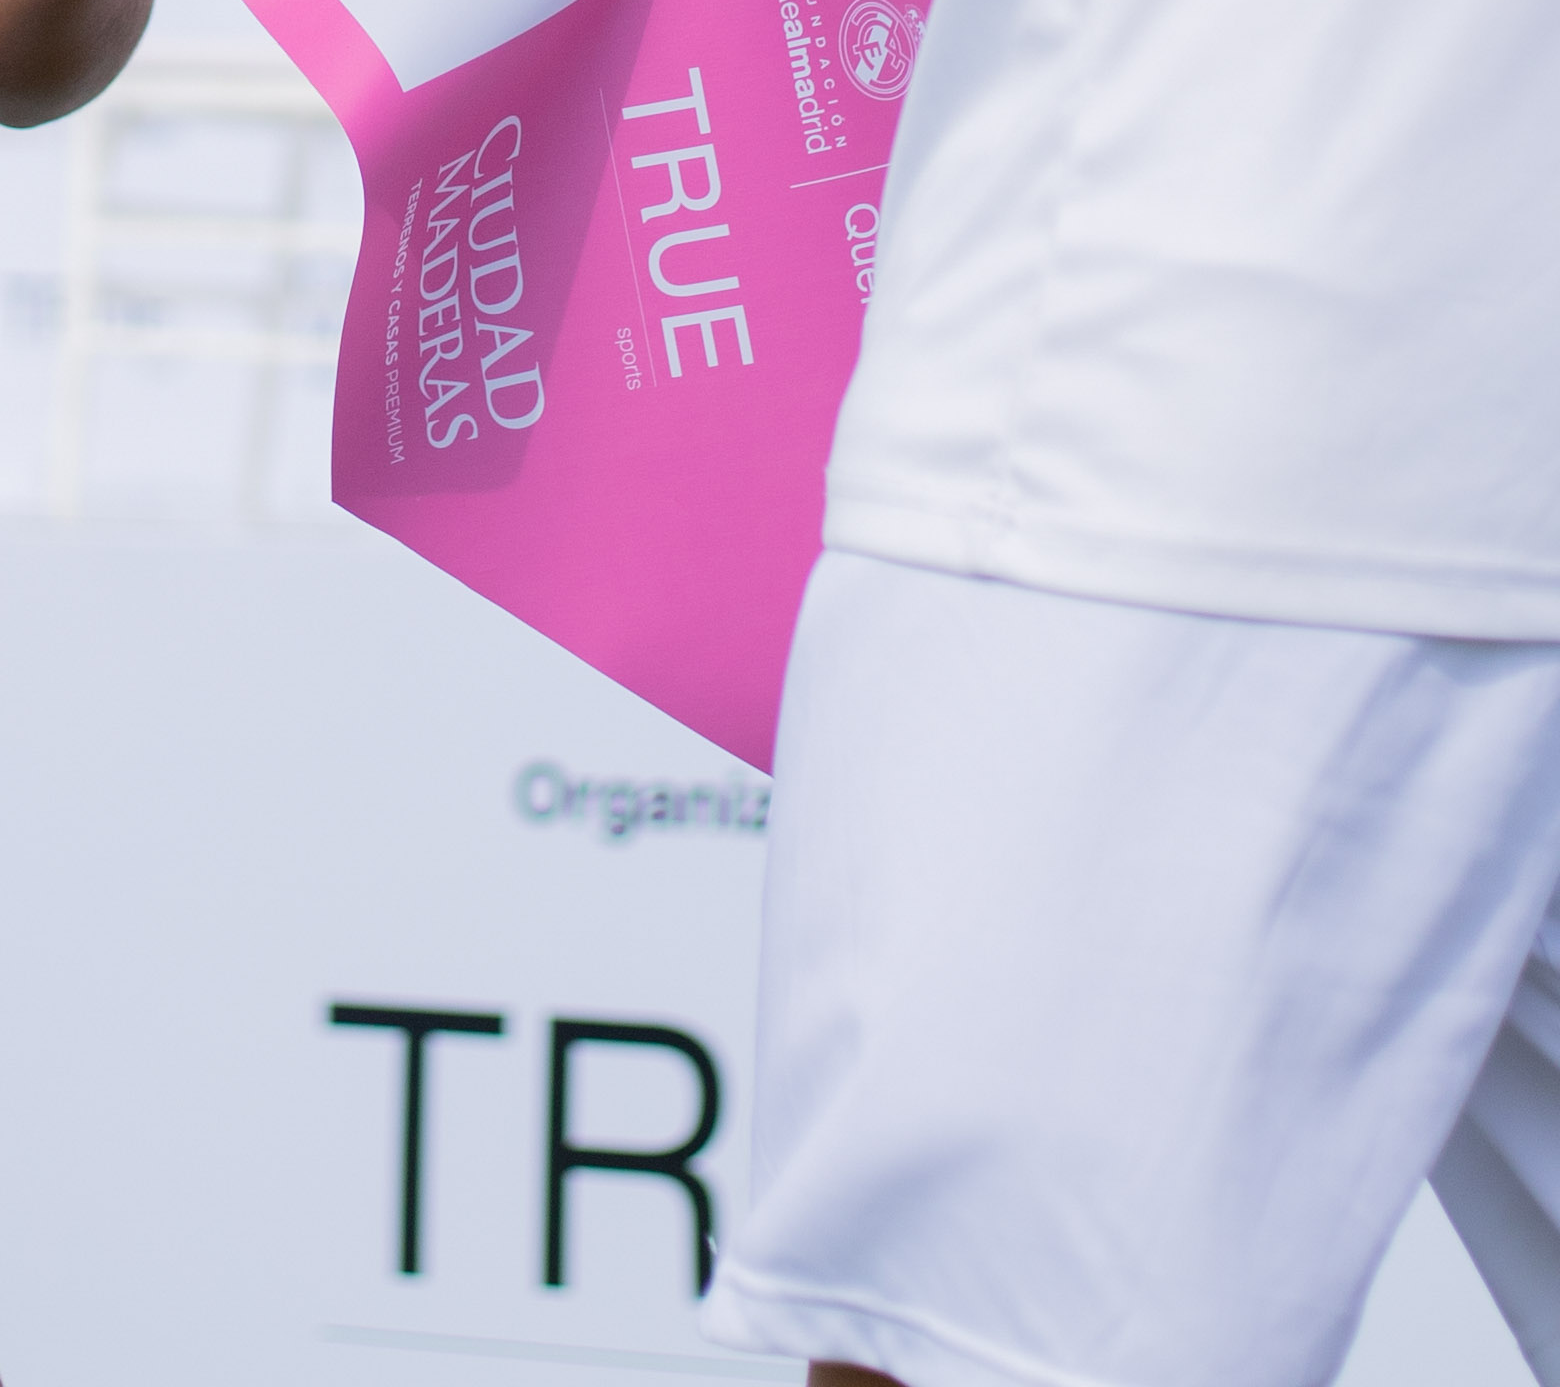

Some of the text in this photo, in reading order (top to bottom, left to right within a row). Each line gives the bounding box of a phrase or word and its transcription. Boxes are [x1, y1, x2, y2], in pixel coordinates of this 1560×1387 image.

[384, 177, 423, 466] TERRENOS Y CASAS PREMIUM
[418, 148, 480, 449] MADERAS
[468, 114, 546, 430] CIUDAD
[614, 326, 642, 391] sports
[621, 66, 755, 378] TRUE
[326, 999, 726, 1301] TR
